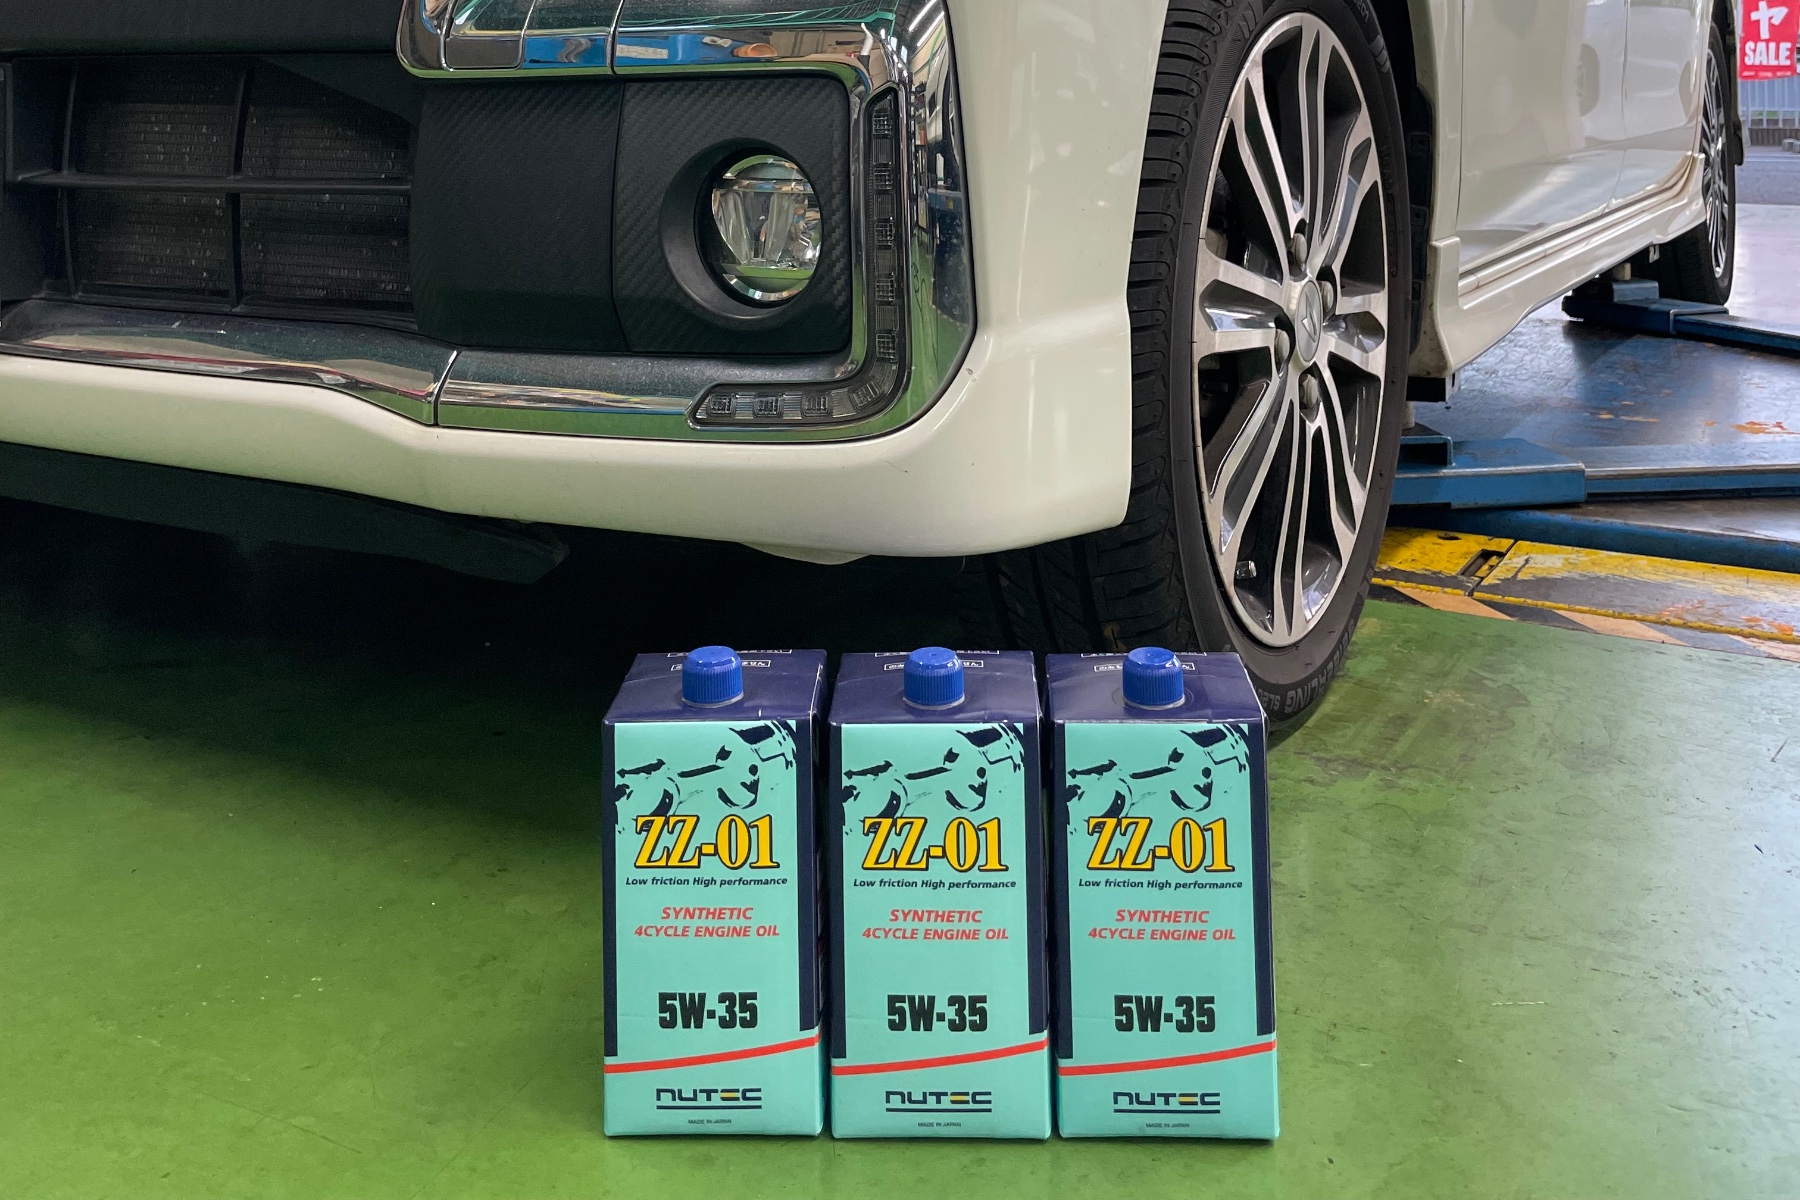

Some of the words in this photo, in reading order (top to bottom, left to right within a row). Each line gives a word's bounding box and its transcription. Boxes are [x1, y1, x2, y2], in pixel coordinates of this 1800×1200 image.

[1744, 41, 1791, 66] SALE
[634, 814, 780, 870] ZZ-01
[862, 817, 1009, 872] ZZ-01
[1087, 817, 1235, 873] ZZ-01
[626, 877, 647, 886] Low
[651, 877, 689, 885] friction
[693, 877, 717, 887] High
[720, 877, 787, 888] performance
[853, 878, 876, 887] Low
[879, 878, 917, 888] friction
[921, 878, 945, 889] High
[948, 878, 1016, 890] performance
[1079, 878, 1101, 887] Low
[1104, 878, 1143, 888] friction
[1147, 878, 1171, 889] High
[1174, 878, 1243, 890] performance
[661, 907, 753, 920] SYNTHETIC
[889, 909, 982, 923] SYNTHETIC
[1116, 909, 1209, 923] SYNTHETIC
[634, 925, 689, 937] 4CYCLE
[694, 925, 751, 937] ENGINE
[756, 925, 780, 937] OIL
[862, 928, 919, 940] 4CYCLE
[923, 928, 980, 940] ENGINE
[985, 928, 1008, 940] OIL
[1088, 928, 1146, 940] 4CYCLE
[1150, 928, 1207, 940] ENGINE
[1212, 928, 1236, 940] OIL
[658, 992, 757, 1029] 5W-35
[887, 994, 988, 1031] 5W-35
[1114, 994, 1216, 1033] 5W-35
[656, 1088, 762, 1101] NUTEC
[885, 1090, 992, 1104] NUTEC
[1113, 1092, 1221, 1105] NUTEC
